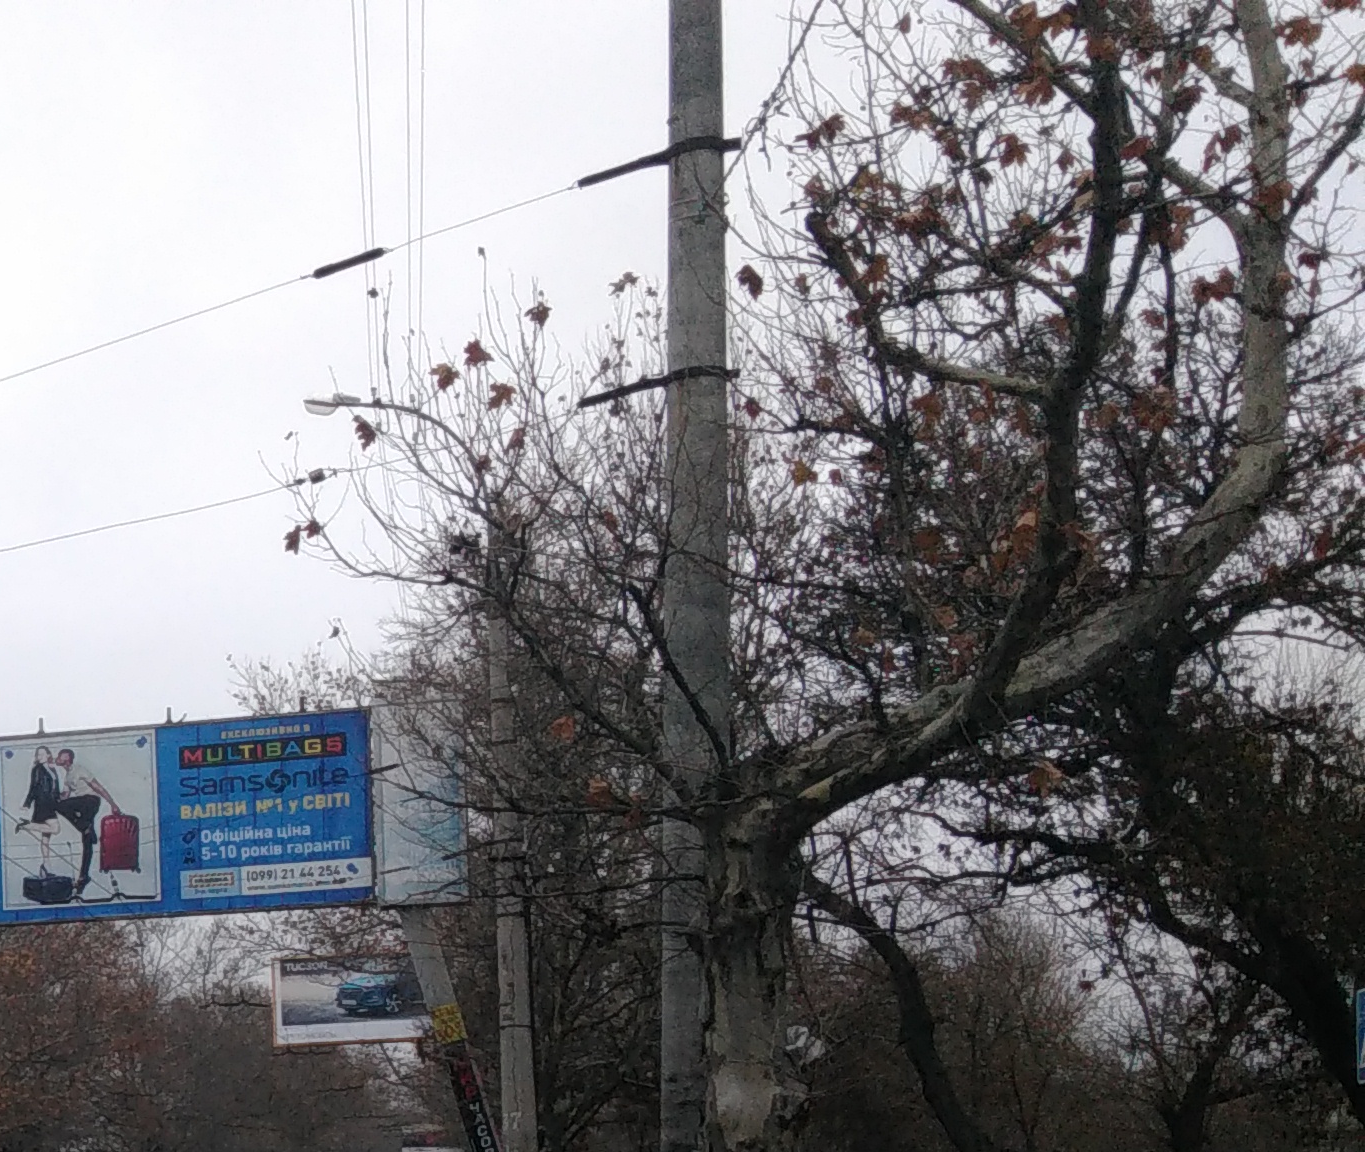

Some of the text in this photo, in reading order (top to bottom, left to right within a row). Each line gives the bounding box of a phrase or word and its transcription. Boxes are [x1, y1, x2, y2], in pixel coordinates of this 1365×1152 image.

[183, 737, 343, 764] MULTIBAGS
[180, 767, 350, 798] Samsonite
[180, 800, 248, 820] ВАЛІЗИ
[303, 792, 350, 811] СВІТІ
[200, 823, 311, 846] Офіційна ціна
[201, 836, 352, 861] 5-10 років гарантії
[246, 864, 341, 884] (099) 21 44 254
